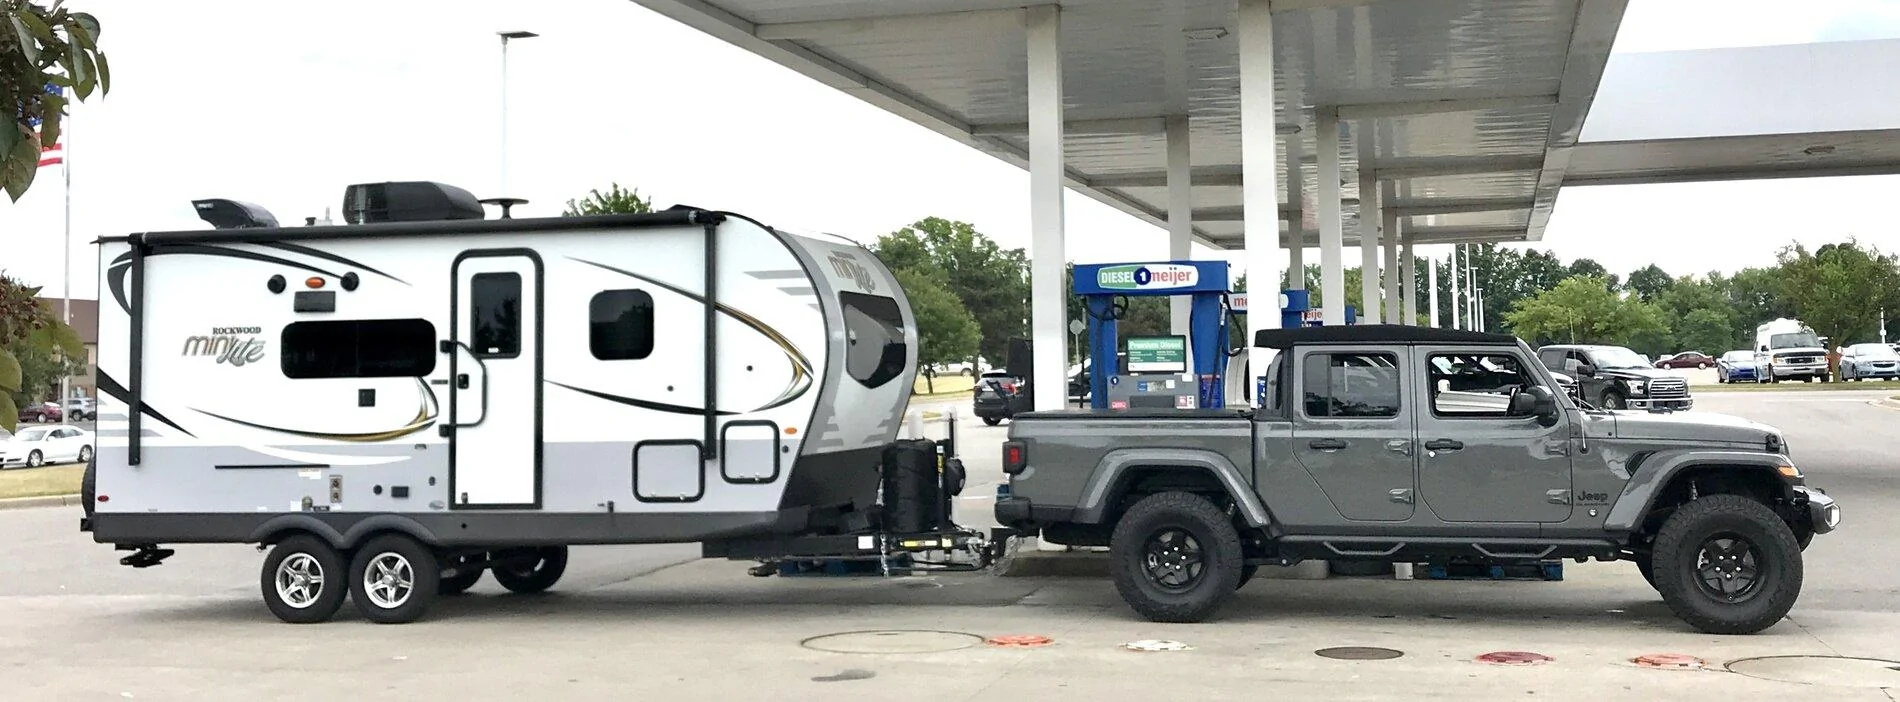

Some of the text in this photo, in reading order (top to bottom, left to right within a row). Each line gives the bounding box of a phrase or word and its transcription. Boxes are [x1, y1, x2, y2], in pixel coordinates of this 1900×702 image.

[1101, 271, 1134, 284] DIESEL
[1139, 271, 1147, 282] 1
[212, 326, 262, 335] ROCKWOOD
[1577, 491, 1608, 502] Jeep
